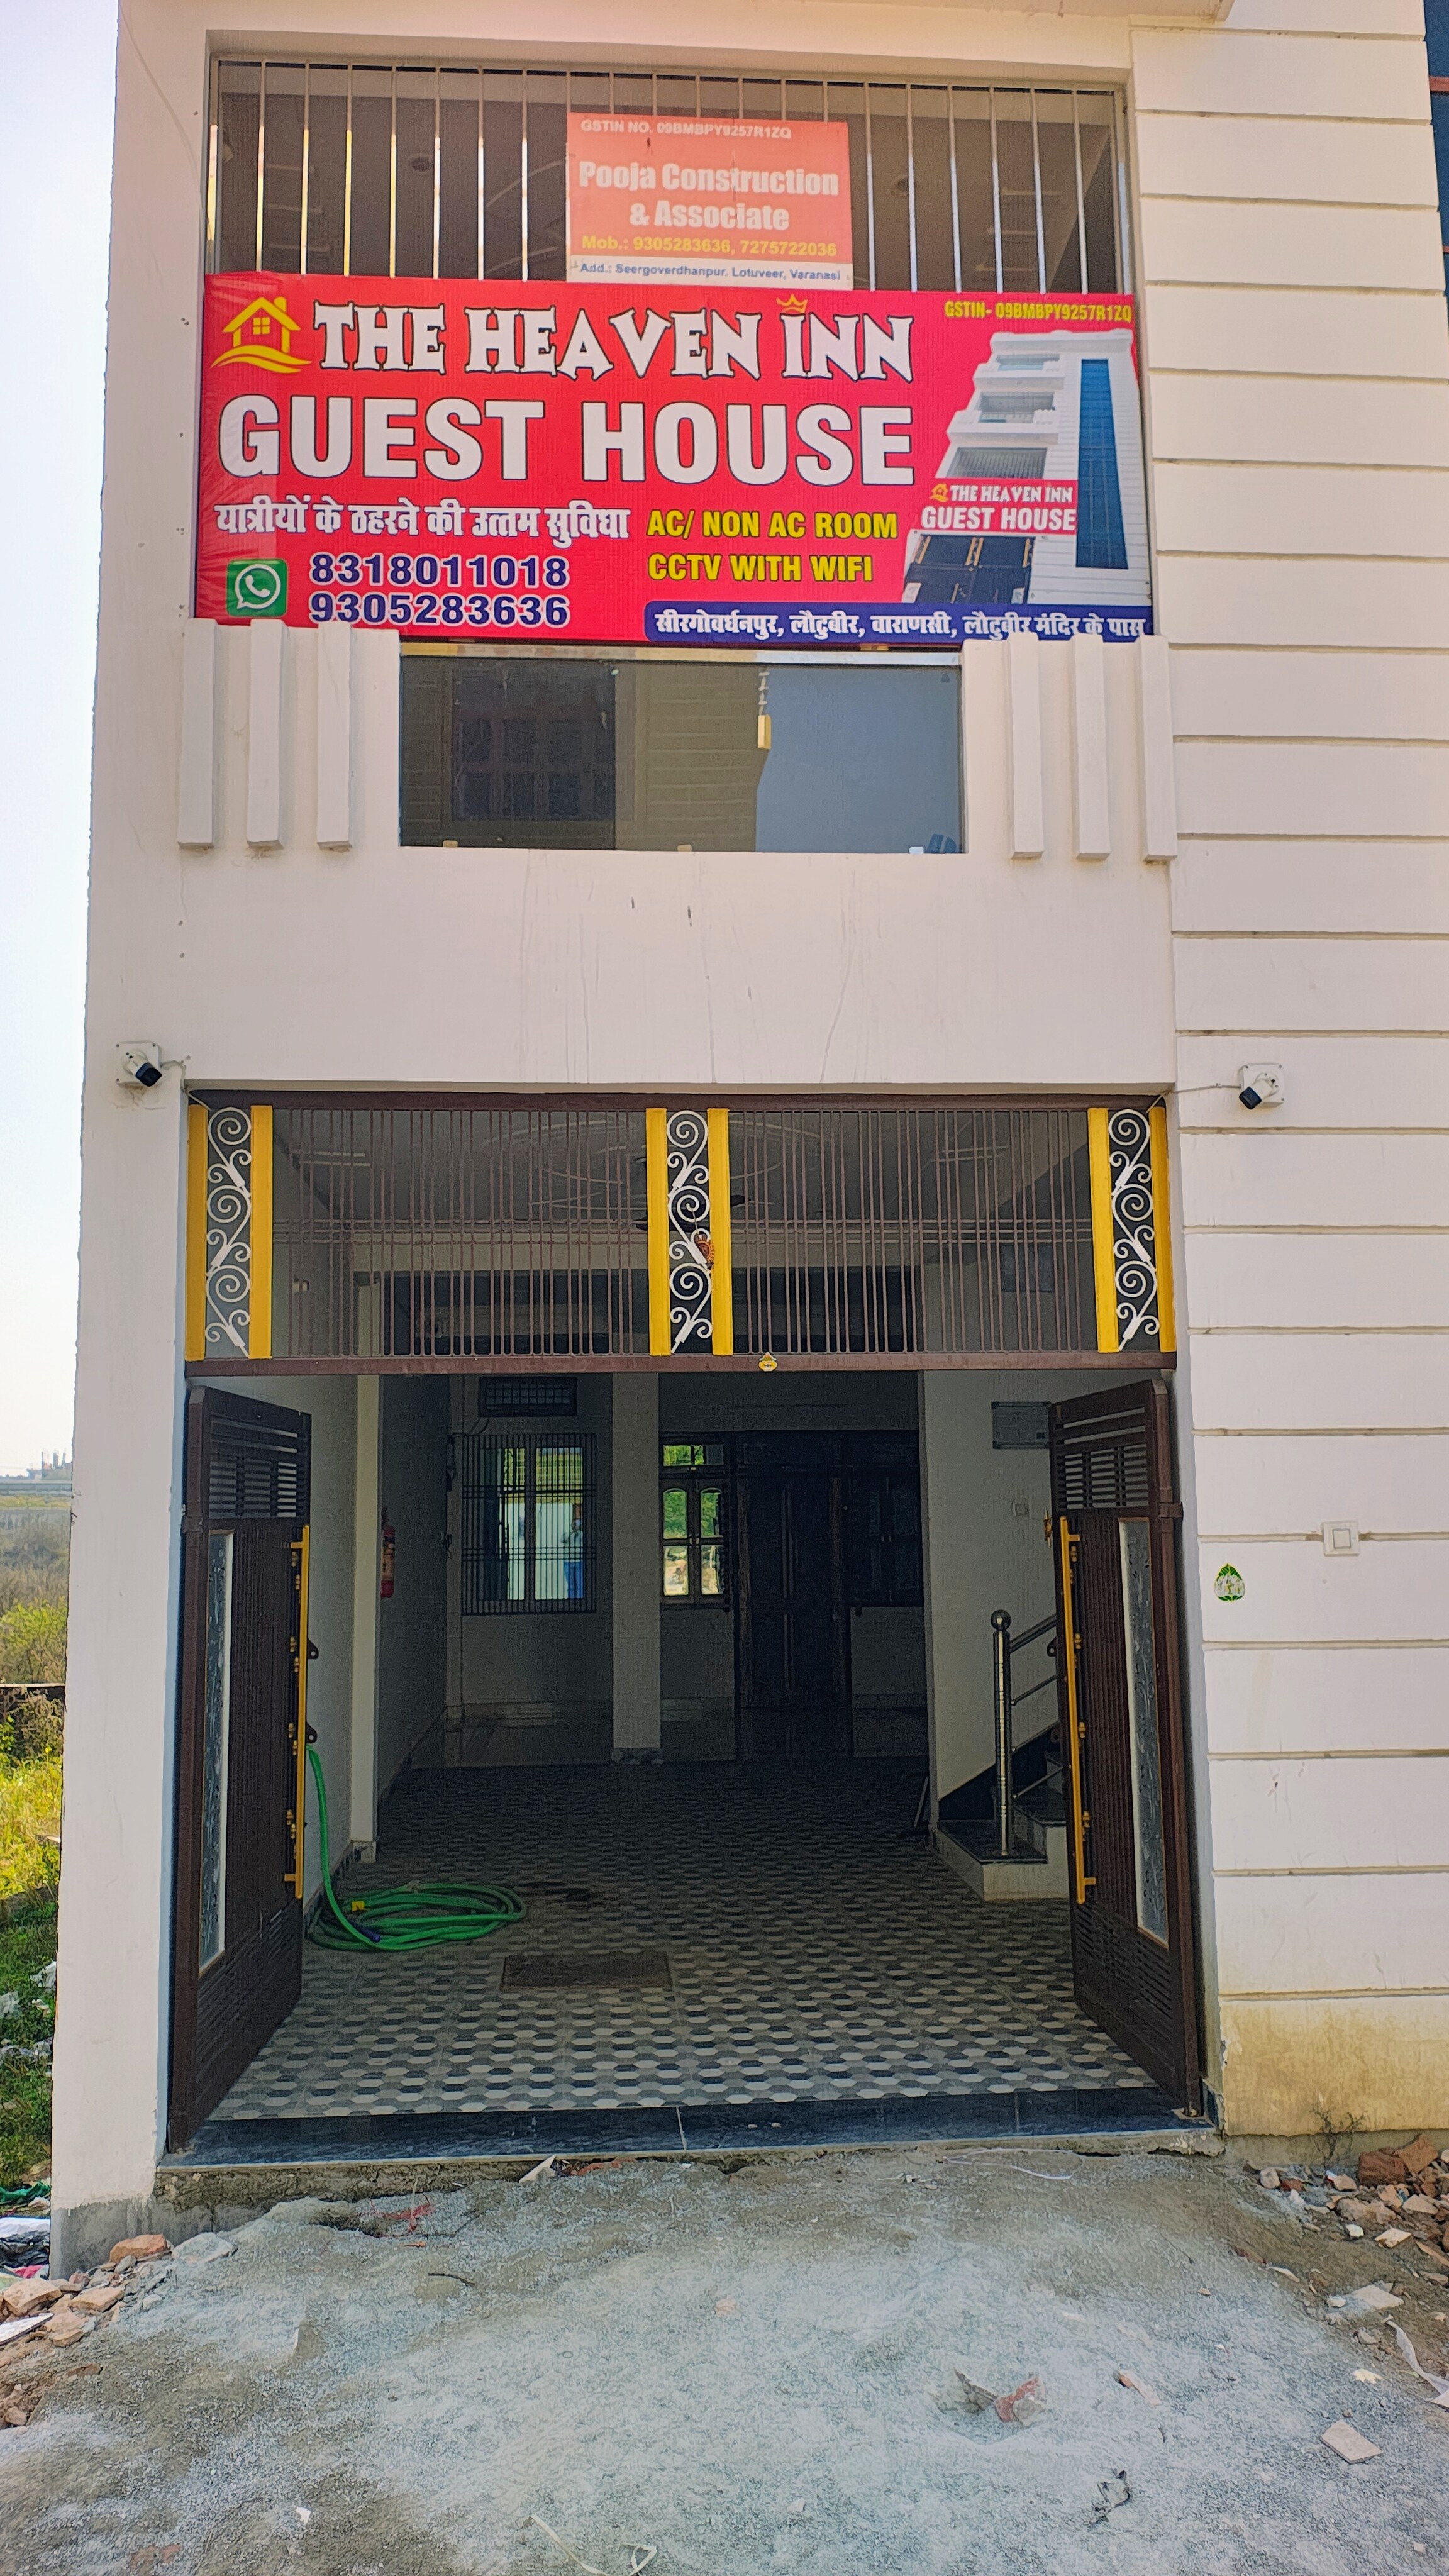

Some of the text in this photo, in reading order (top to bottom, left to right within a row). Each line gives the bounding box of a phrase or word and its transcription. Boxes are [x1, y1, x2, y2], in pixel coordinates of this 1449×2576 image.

[581, 119, 624, 133] GSTIN
[628, 121, 652, 133] NO.
[579, 161, 839, 196] Pooja Construction
[630, 199, 789, 231] & Associate
[582, 235, 837, 257] Mob.: 9305283636, 7275722036
[580, 263, 612, 274] Add.:
[790, 269, 840, 280] Varanasi
[945, 301, 992, 318] GSTIN-
[313, 300, 914, 383] THE HEAVEN INN
[219, 394, 914, 487] GUEST HOUSE
[950, 485, 1073, 502] THE HEAVEN INN
[214, 494, 630, 548] यात्रीयों के ठहरने की उत्तम सुविधा
[647, 509, 897, 539] AC/ NON AC ROOM
[921, 507, 1076, 531] GUEST HOUSE
[309, 552, 570, 588] 8318011018
[648, 553, 872, 581] CCTV WITH WIFI
[308, 592, 571, 627] 9305283636
[1034, 613, 1080, 635] मंदिर
[1083, 613, 1104, 635] के
[1107, 618, 1146, 636] पास
